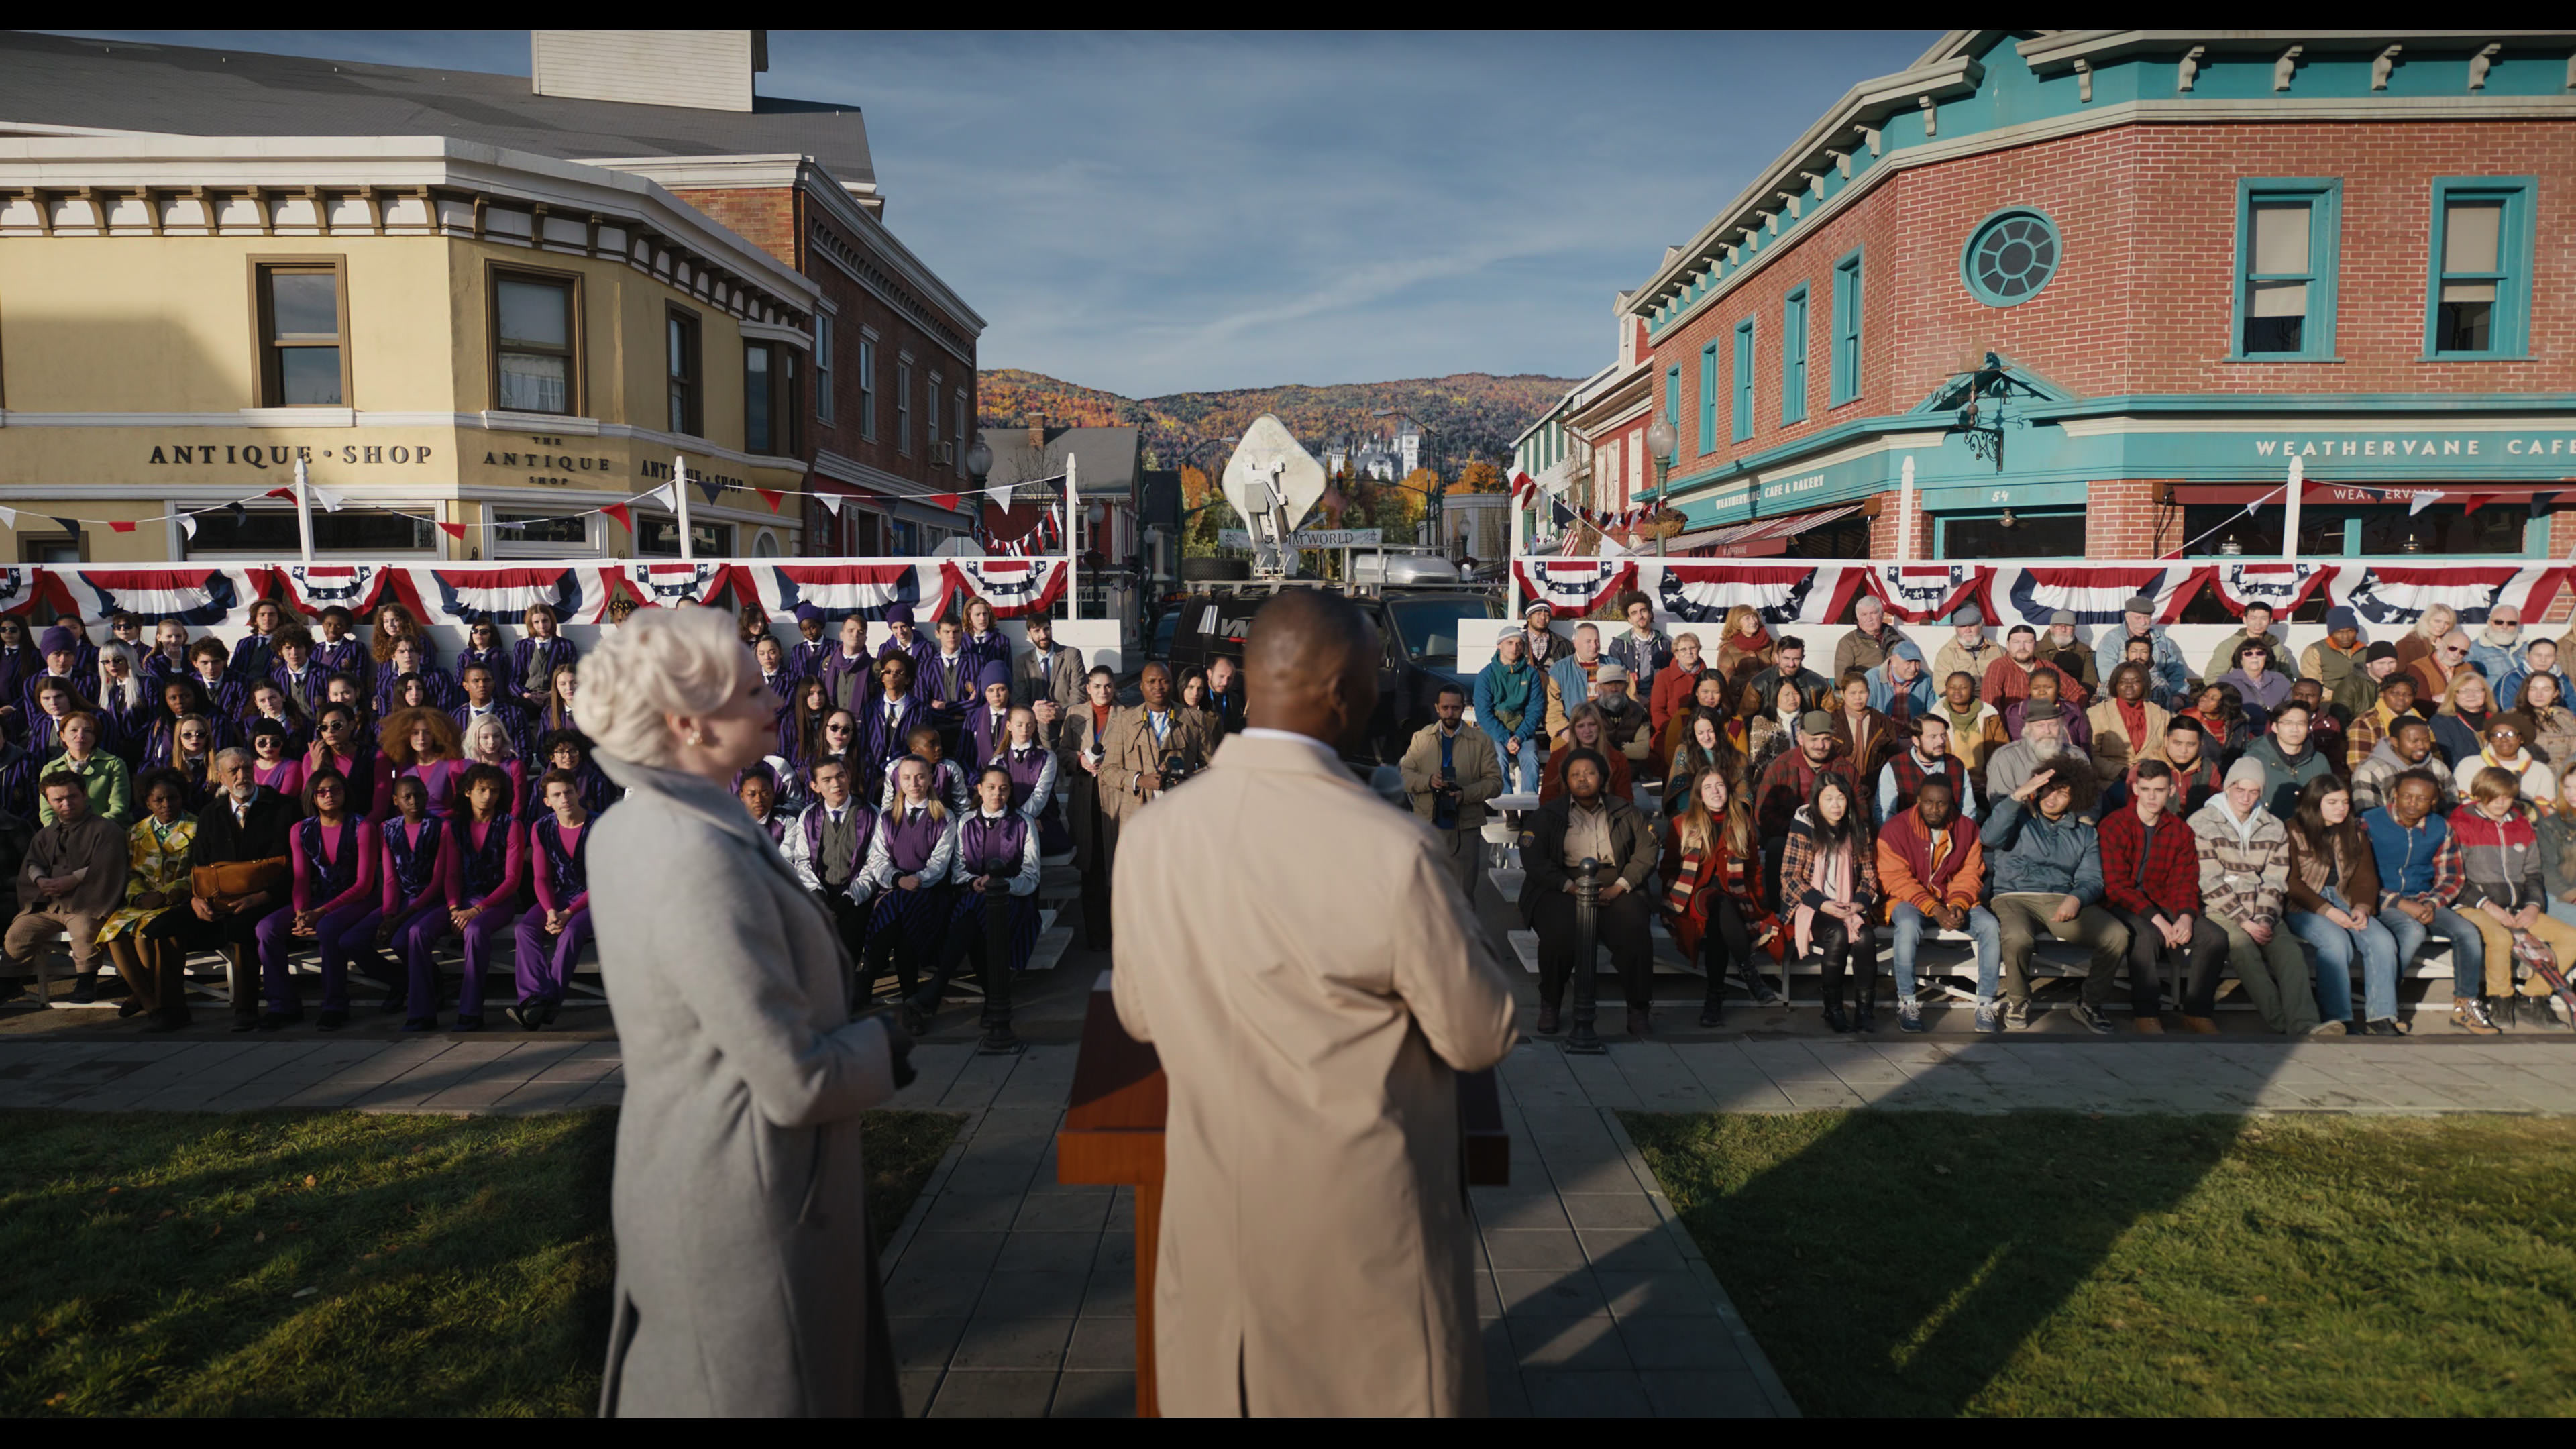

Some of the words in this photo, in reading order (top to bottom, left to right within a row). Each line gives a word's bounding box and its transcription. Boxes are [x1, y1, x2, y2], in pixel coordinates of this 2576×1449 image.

[532, 437, 562, 446] THE
[2256, 439, 2480, 457] WEATHERVANE
[149, 445, 313, 469] ANTIQUE
[343, 445, 432, 464] SHOP
[483, 451, 610, 472] ANTIQUE
[529, 476, 569, 485] SHOP
[641, 460, 701, 485] ANTIUE
[1764, 484, 1783, 498] CAFE
[1792, 474, 1824, 492] BAKERY
[1991, 490, 2010, 502] 54
[1308, 533, 1354, 545] WORLD
